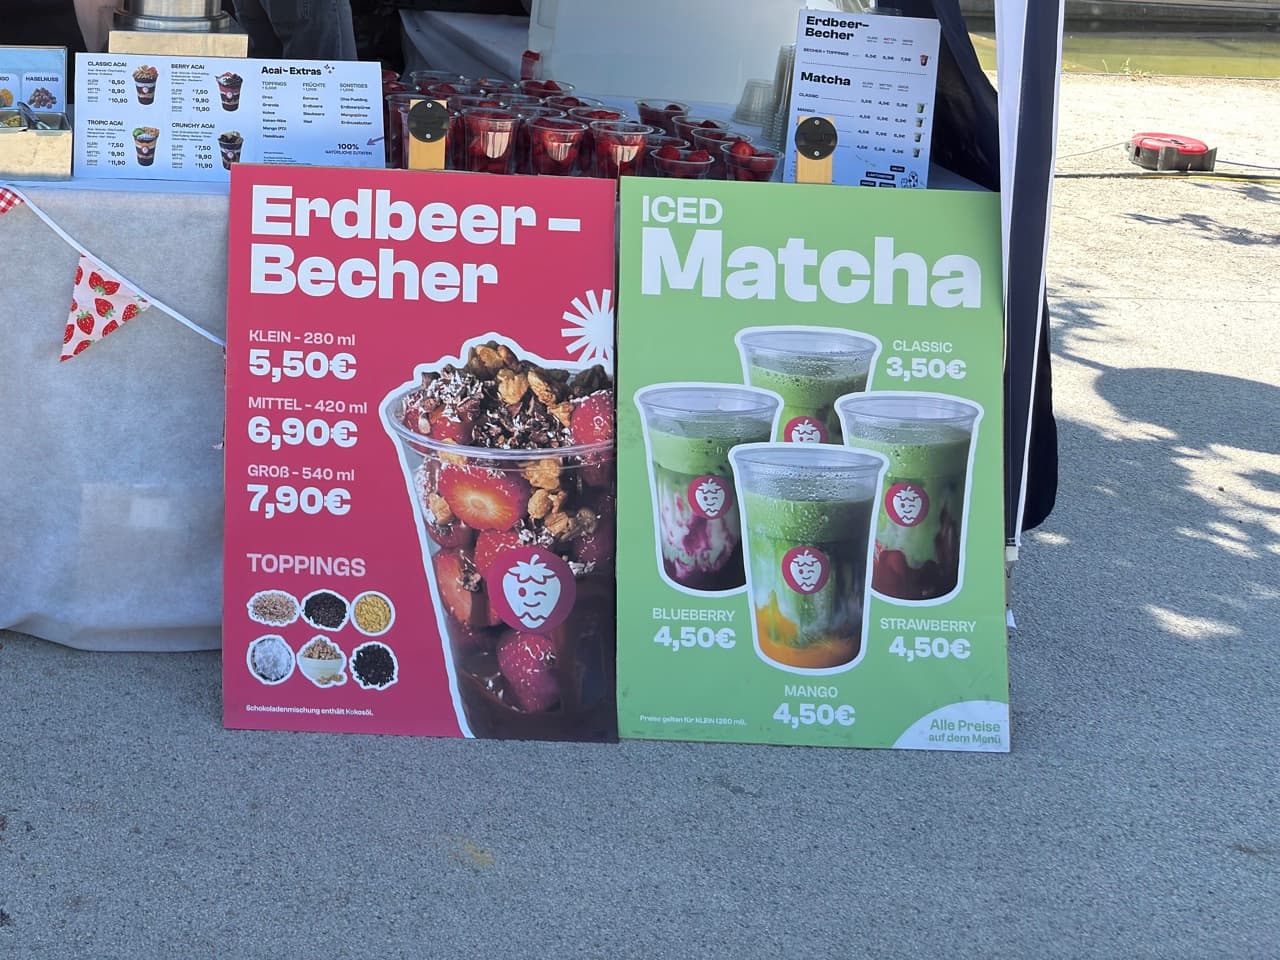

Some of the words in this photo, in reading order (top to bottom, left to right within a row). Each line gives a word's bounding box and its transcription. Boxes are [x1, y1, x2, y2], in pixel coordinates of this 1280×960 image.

[806, 16, 869, 29] Erdbeer-
[806, 28, 854, 40] Becher
[800, 72, 851, 86] Matcha
[641, 195, 723, 225] ICED
[250, 243, 498, 303] Becher
[641, 227, 982, 309] Matcha
[249, 329, 291, 344] KLEIN
[304, 332, 334, 346] 280
[337, 332, 356, 346] ml
[892, 340, 953, 353] CLASSIC
[248, 348, 357, 383] 5,50€
[886, 357, 967, 383] 3,50€
[248, 396, 303, 412] MITTEL
[314, 399, 346, 414] 420
[349, 399, 368, 415] ml
[248, 416, 358, 451] 6,90€
[302, 467, 333, 480] 540
[336, 467, 355, 481] ml
[246, 484, 351, 520] 7,90€
[246, 553, 366, 577] TOPPINGS
[652, 607, 736, 622] BLUEBERRY
[880, 618, 976, 633] STRAWBERRY
[653, 626, 737, 653] 4,50€
[888, 636, 971, 662] 4,50€
[784, 684, 839, 699] MANGO
[246, 704, 320, 715] Schokoladenmischung
[772, 702, 856, 729] 4,50€
[930, 719, 962, 732] Alle
[965, 720, 1001, 733] Preise
[929, 733, 945, 743] auf
[947, 733, 970, 743] dem
[972, 732, 1001, 744] Menü
